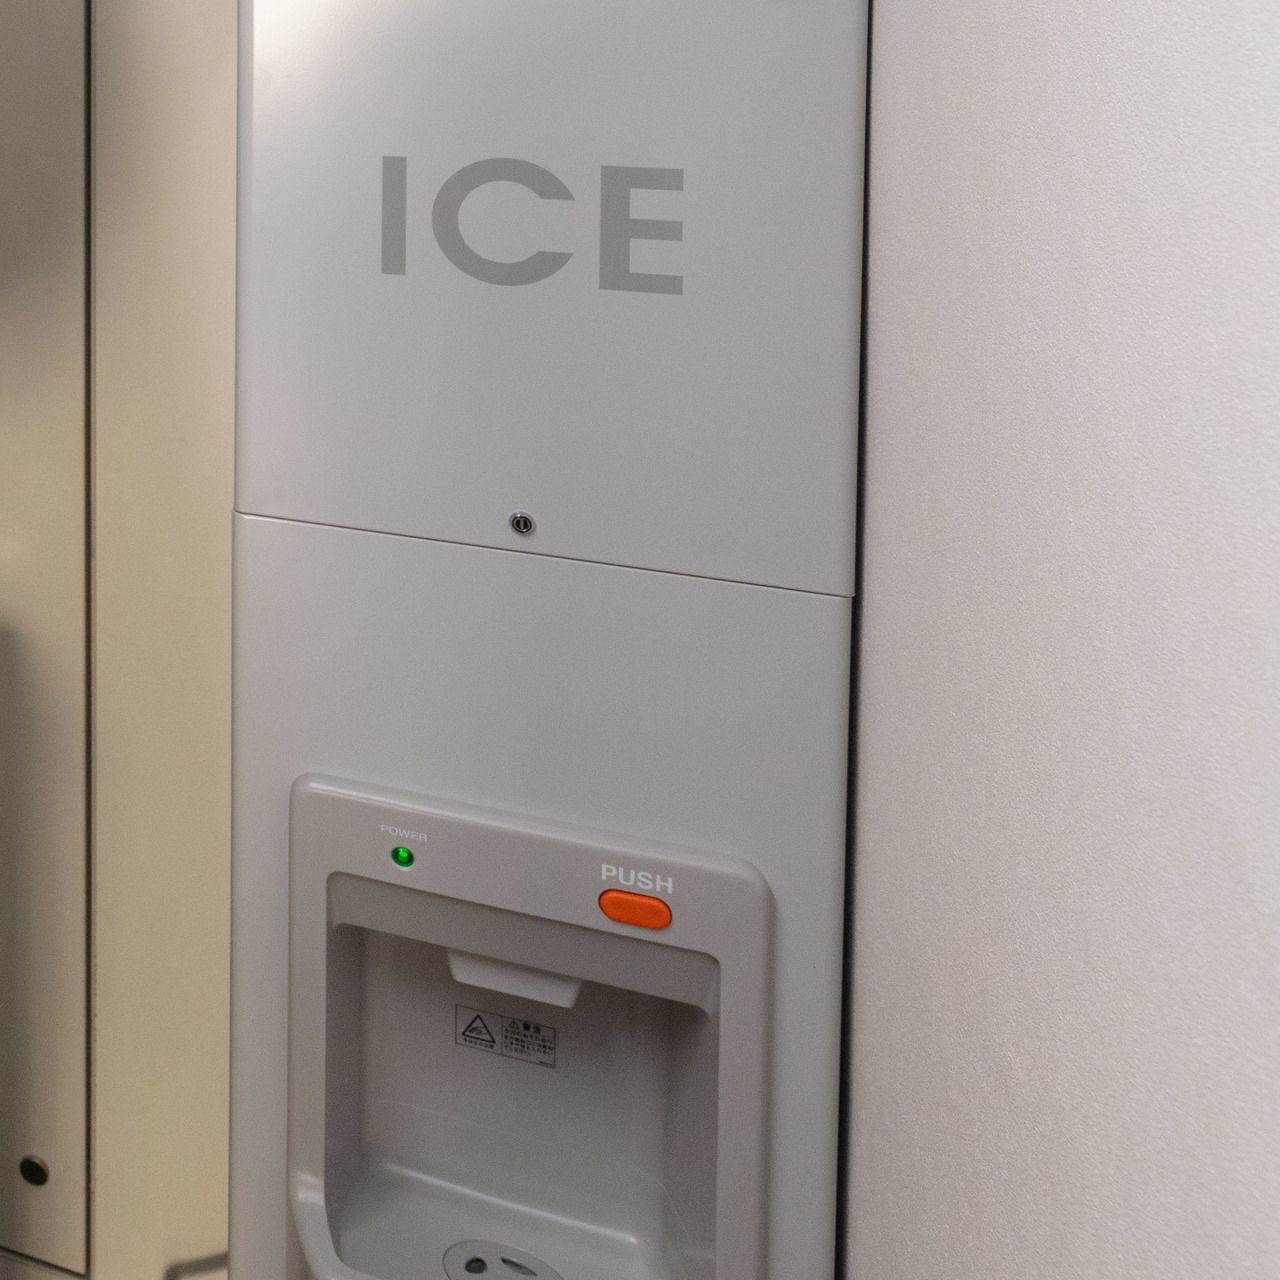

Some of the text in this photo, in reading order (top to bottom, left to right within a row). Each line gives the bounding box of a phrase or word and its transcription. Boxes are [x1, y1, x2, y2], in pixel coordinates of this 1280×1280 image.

[380, 155, 685, 296] ICE
[380, 823, 428, 844] POWER
[600, 863, 674, 894] PUSH
